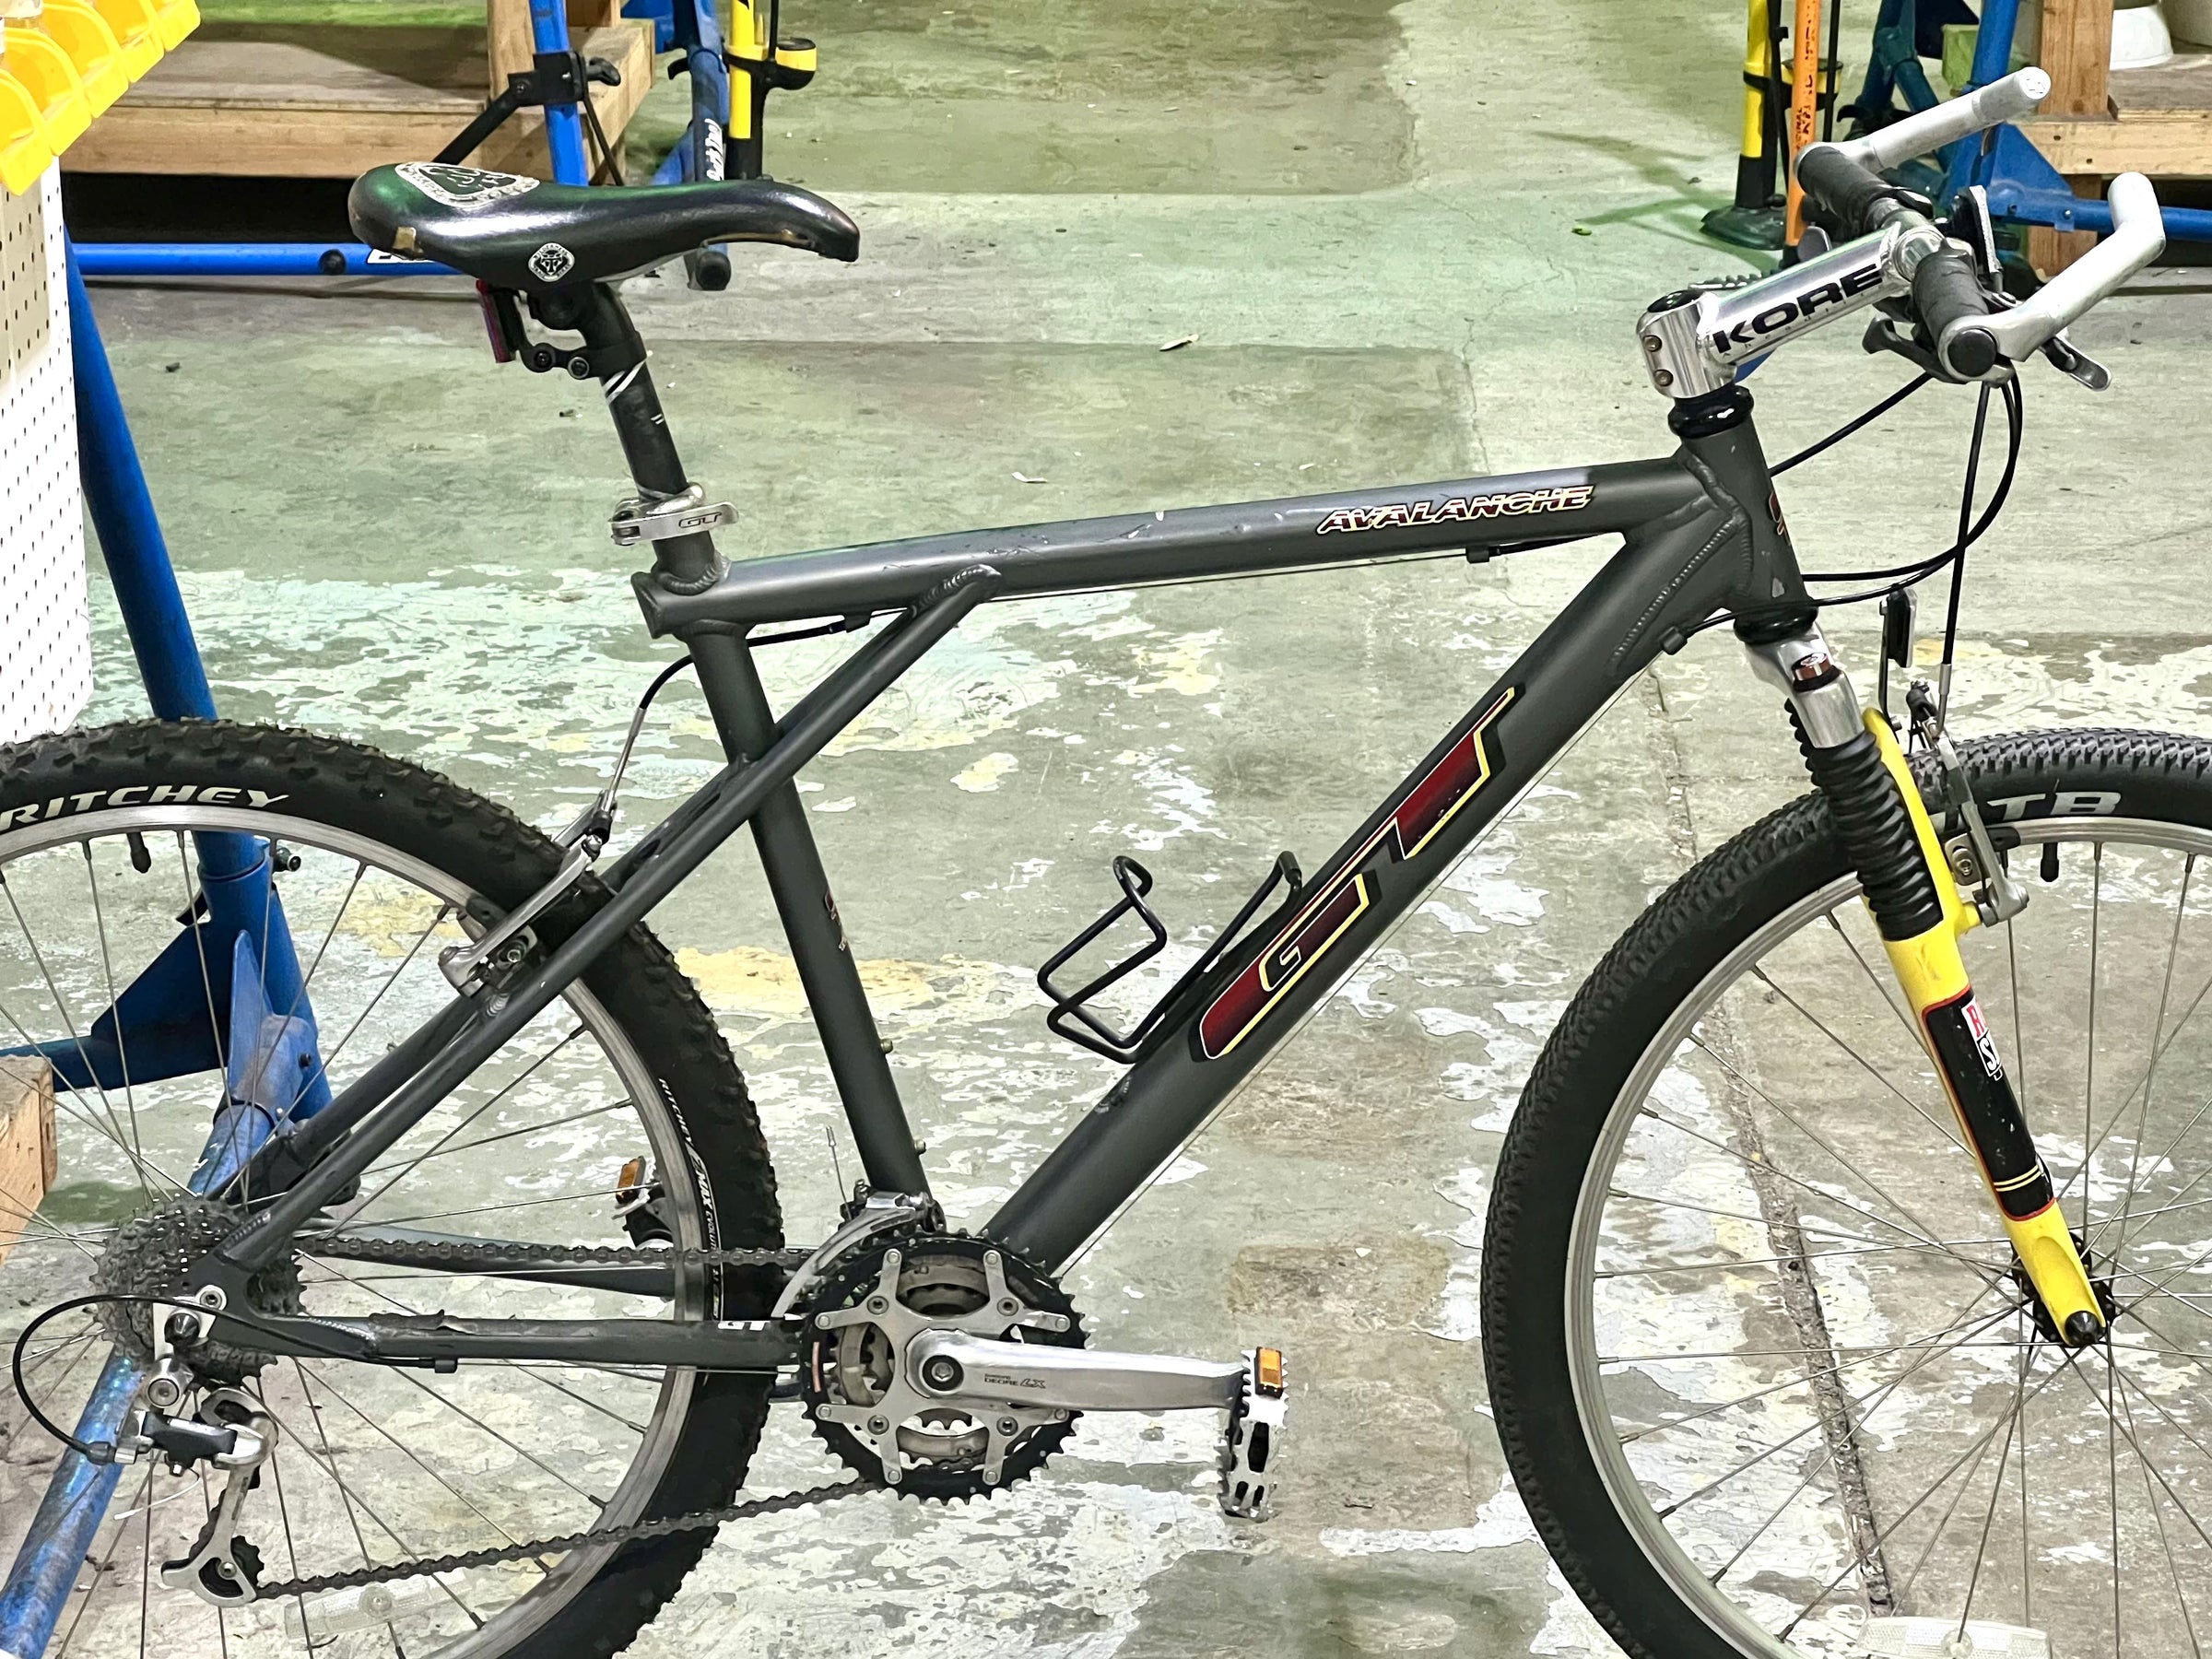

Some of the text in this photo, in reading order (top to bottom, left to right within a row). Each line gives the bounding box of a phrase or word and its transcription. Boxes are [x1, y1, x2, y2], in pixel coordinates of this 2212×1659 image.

[1712, 264, 1883, 354] KORE
[678, 512, 722, 529] GT
[1316, 486, 1594, 535] AVALANCHE
[0, 785, 289, 829] RITCHEY
[1199, 686, 1515, 1061] GT
[658, 1077, 695, 1147] RITCHEY
[1019, 1378, 1046, 1389] LX
